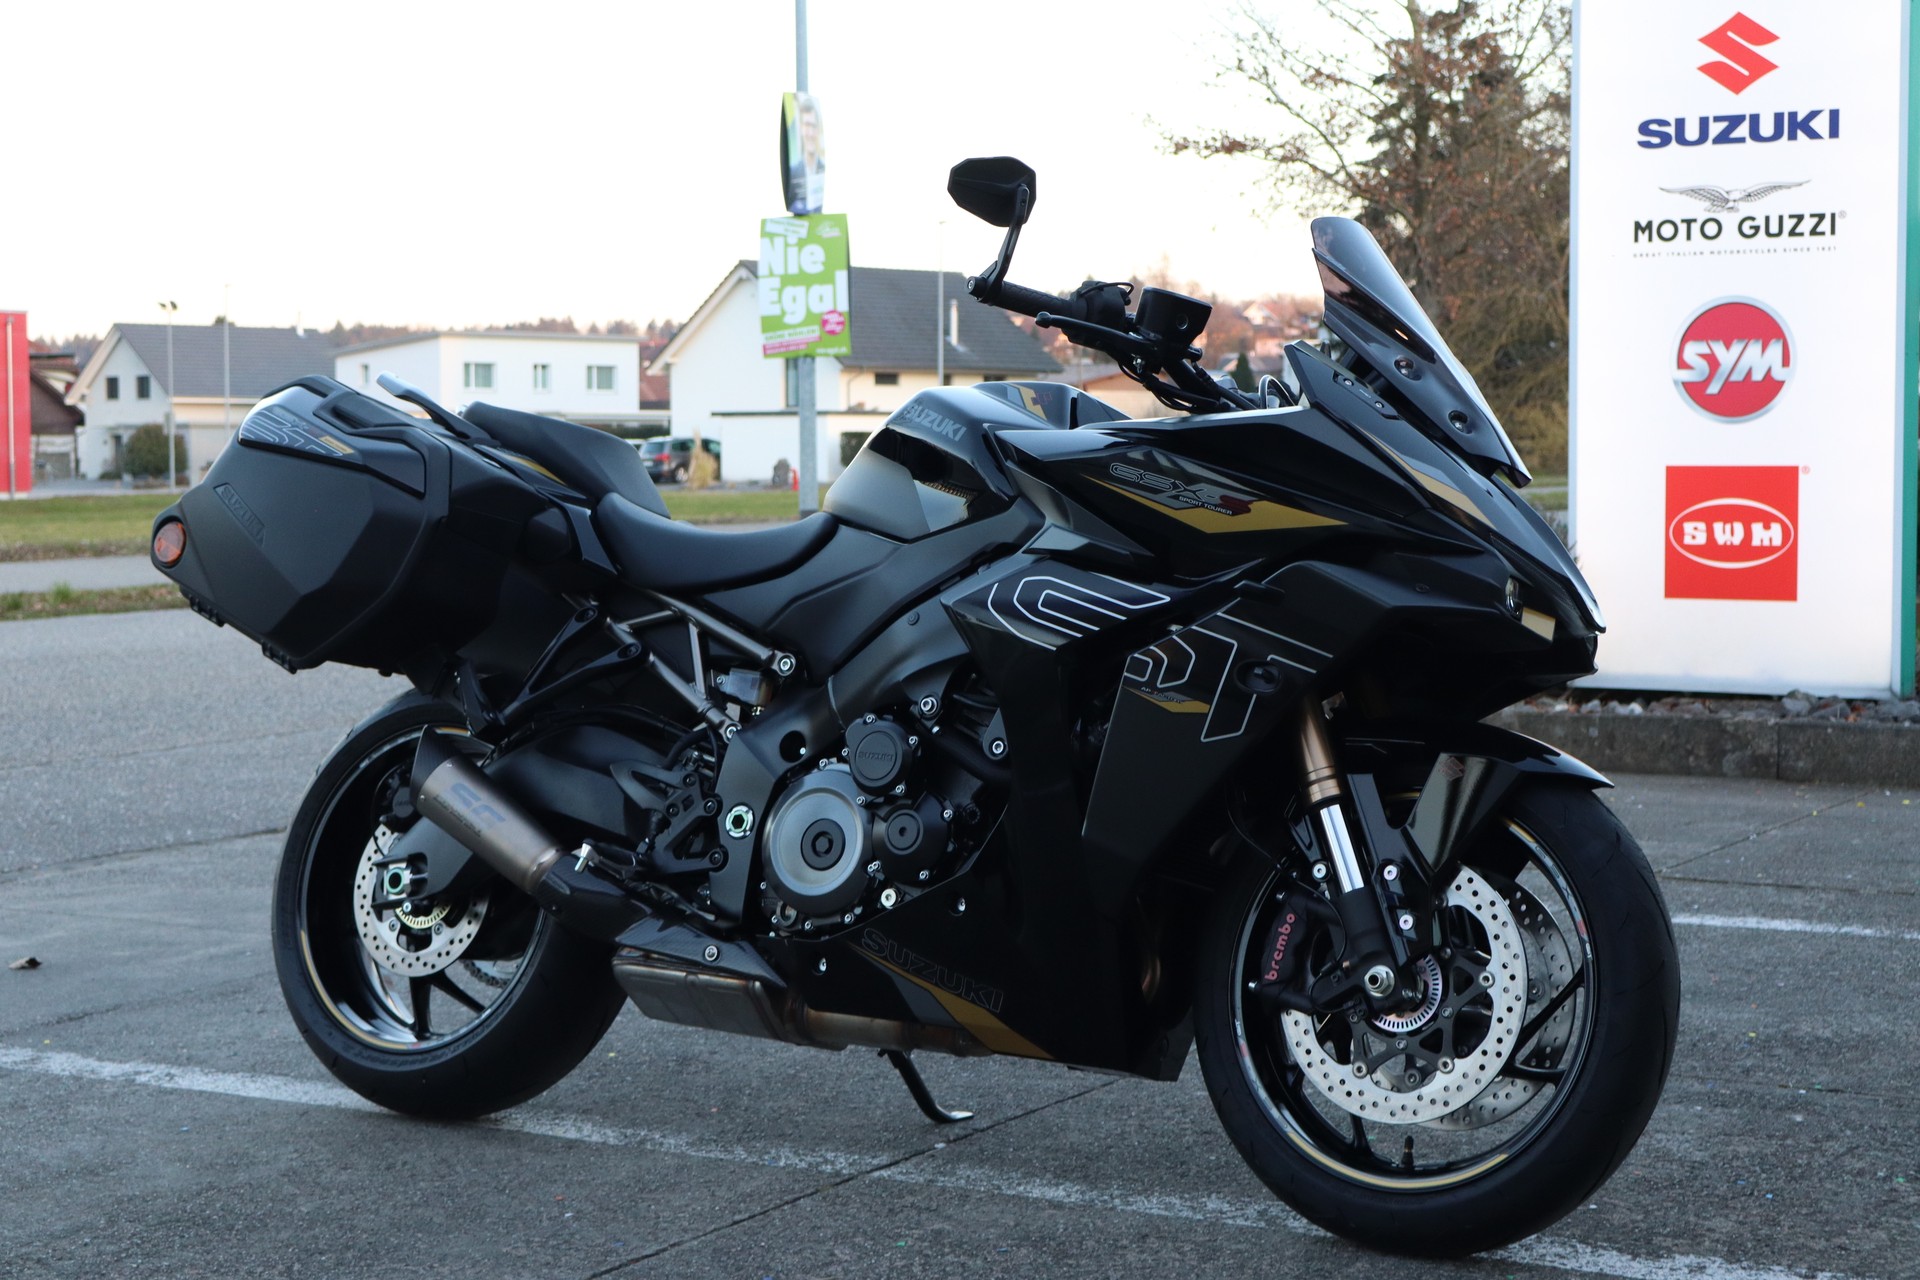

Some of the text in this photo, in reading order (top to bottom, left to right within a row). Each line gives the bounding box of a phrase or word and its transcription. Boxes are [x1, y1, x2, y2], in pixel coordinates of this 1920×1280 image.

[1637, 108, 1840, 149] SUZUKI
[1634, 212, 1836, 243] MOTO GUZZI
[759, 236, 826, 276] Nie
[758, 270, 849, 325] Egal
[1672, 338, 1791, 395] SYM
[904, 403, 967, 442] SUZUKI
[1178, 495, 1233, 516] SPORT TOURER
[1682, 521, 1783, 547] SWM
[862, 928, 1004, 1013] SUZUKI
[1263, 912, 1297, 991] brembo
